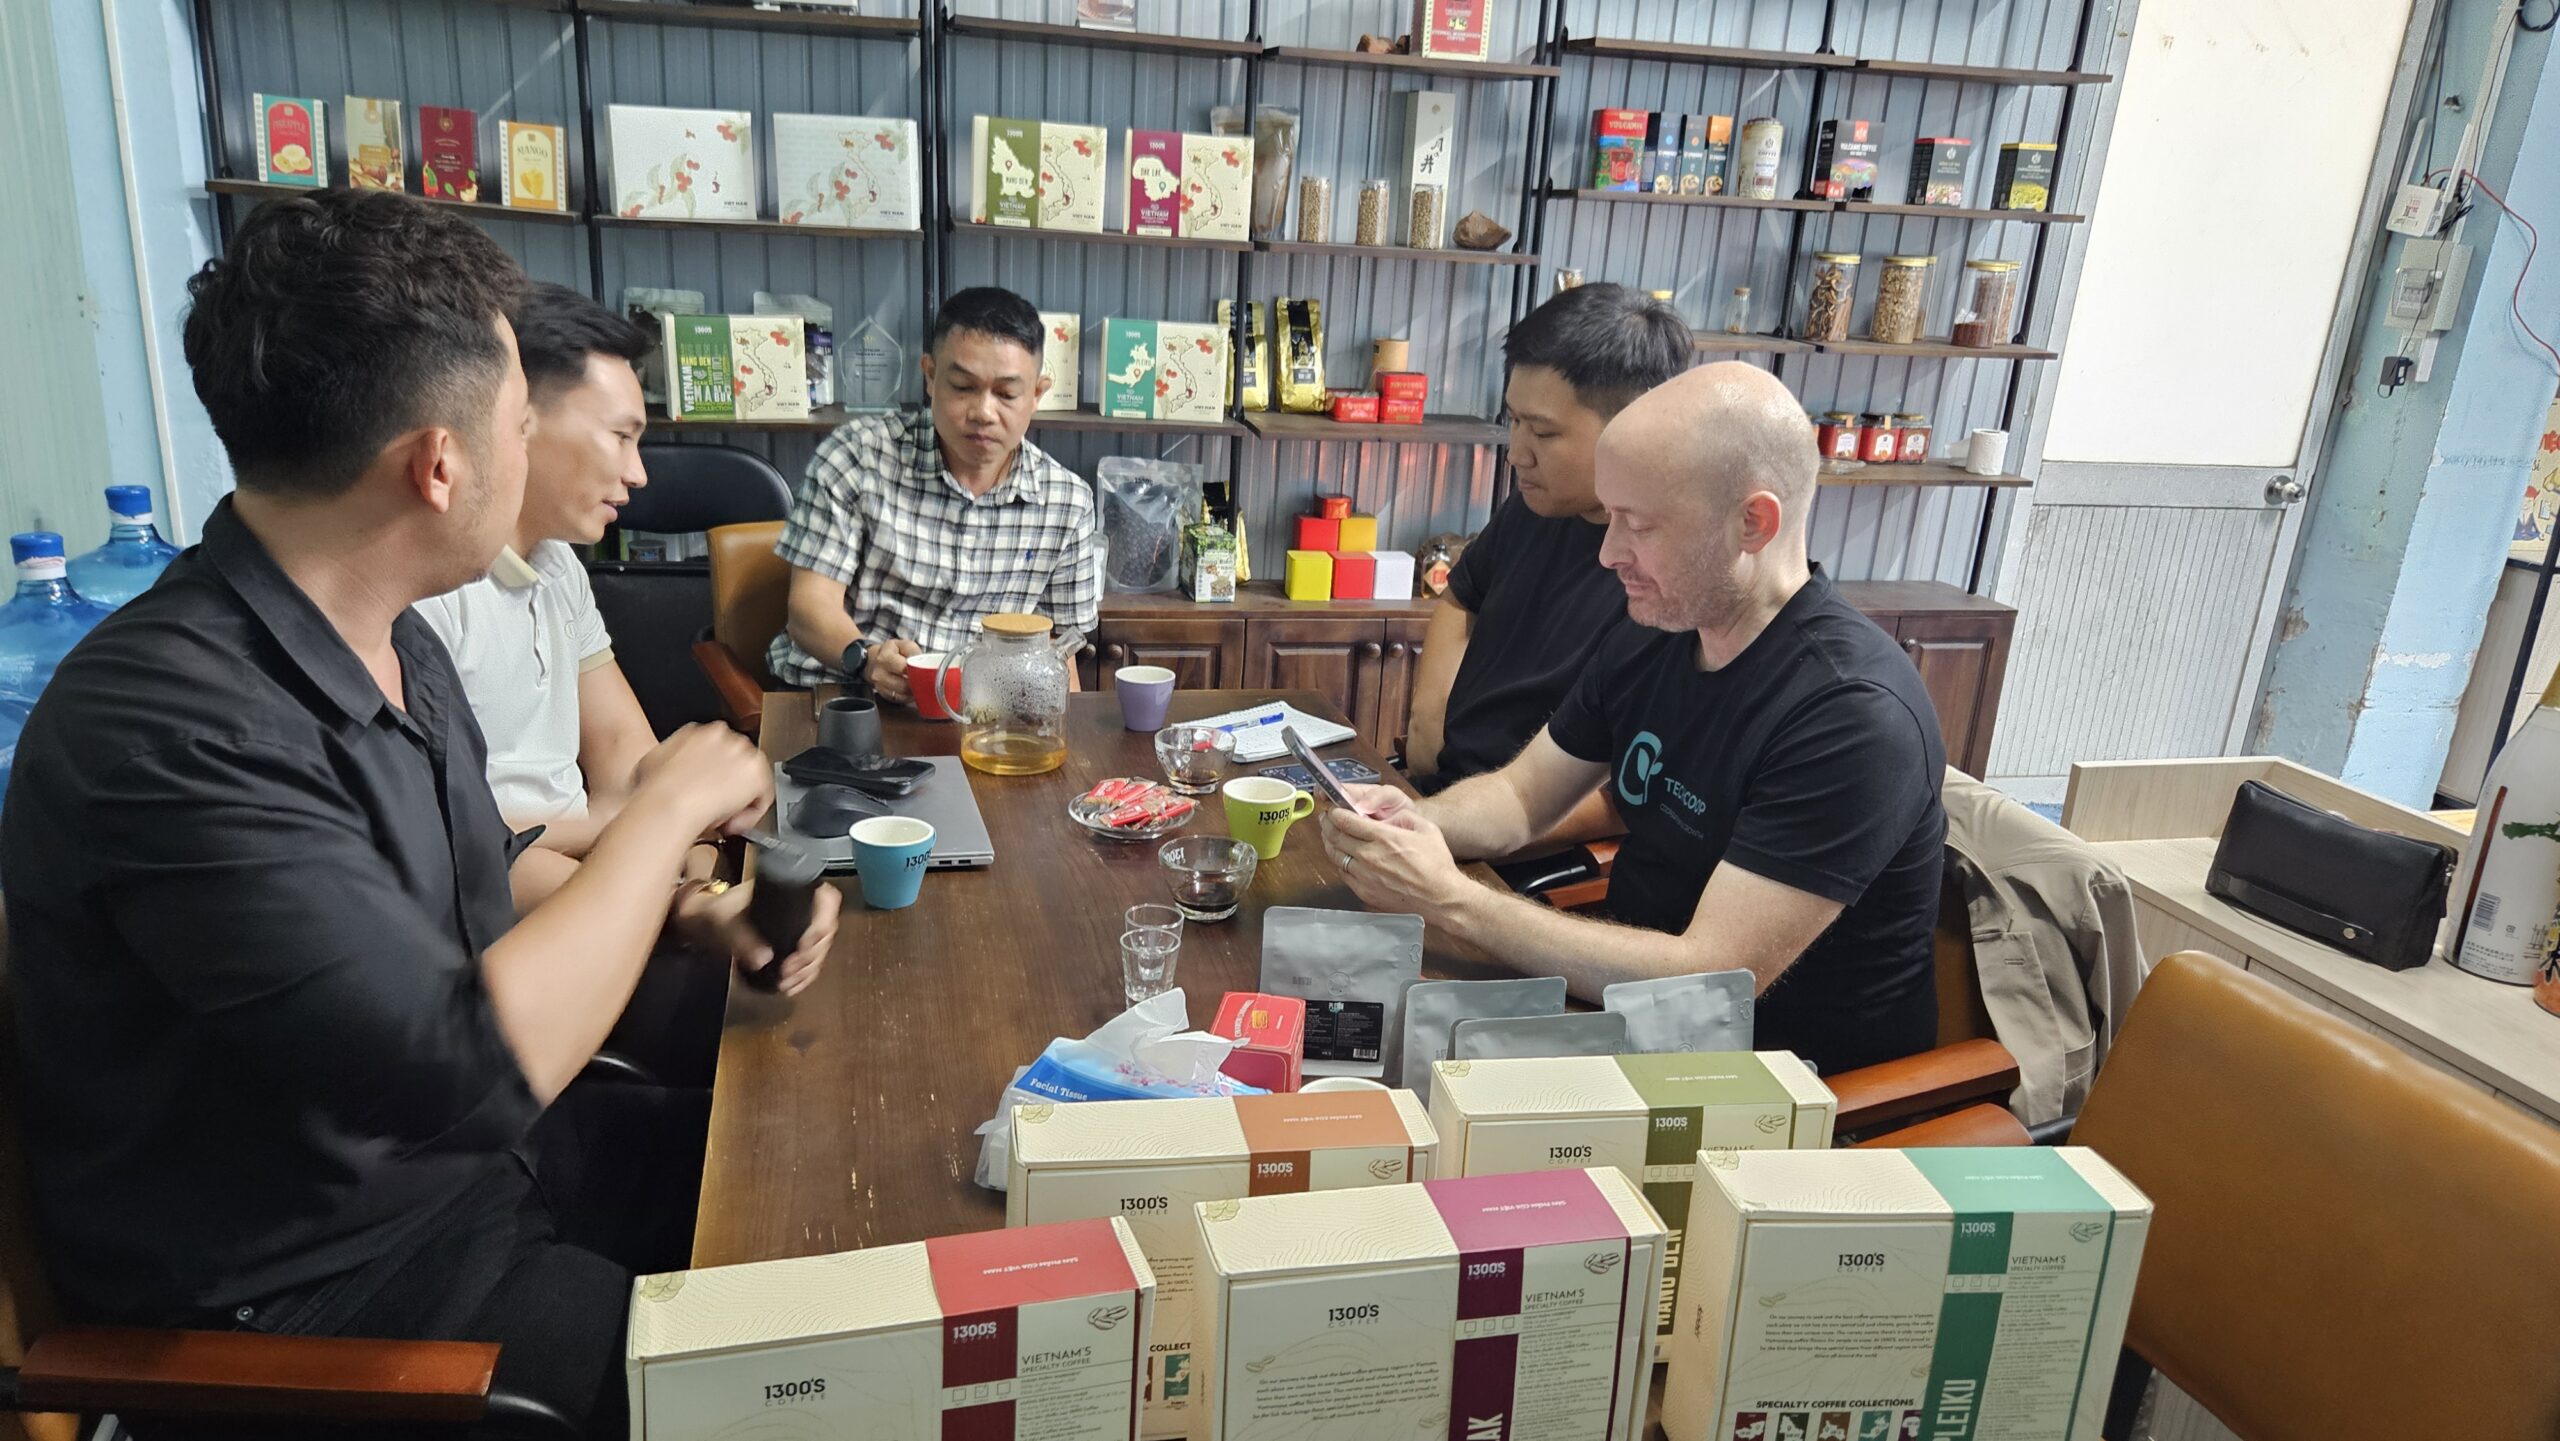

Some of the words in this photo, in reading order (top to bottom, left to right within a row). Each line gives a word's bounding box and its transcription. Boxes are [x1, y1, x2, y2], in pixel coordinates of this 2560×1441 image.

[517, 144, 548, 157] MANGO
[1140, 210, 1169, 218] VIETNAM
[682, 365, 695, 413] VIETNAM
[1029, 1078, 1059, 1094] Facial
[1060, 1087, 1088, 1101] Tissue
[1549, 1144, 1592, 1159] 1300'S
[1120, 1195, 1168, 1210] 1300'S
[1838, 1252, 1885, 1266] 1300'S
[2011, 1255, 2067, 1265] VIETNAM'S
[1525, 1288, 1585, 1303] VIETNAM'S
[1328, 1302, 1380, 1322] 1300'S
[1524, 1301, 1558, 1311] SPECIALTY
[1149, 1343, 1191, 1352] COLLECT
[1021, 1346, 1092, 1365] VIETNAM'S
[1020, 1362, 1060, 1374] SPECIALTY
[764, 1376, 826, 1400] 1300'S
[764, 1393, 825, 1408] COFFEE
[1755, 1400, 1809, 1410] SPECIALTY
[1811, 1400, 1847, 1409] COFFEE
[1848, 1398, 1915, 1408] COLLECTIONS
[1466, 1412, 1504, 1441] AK
